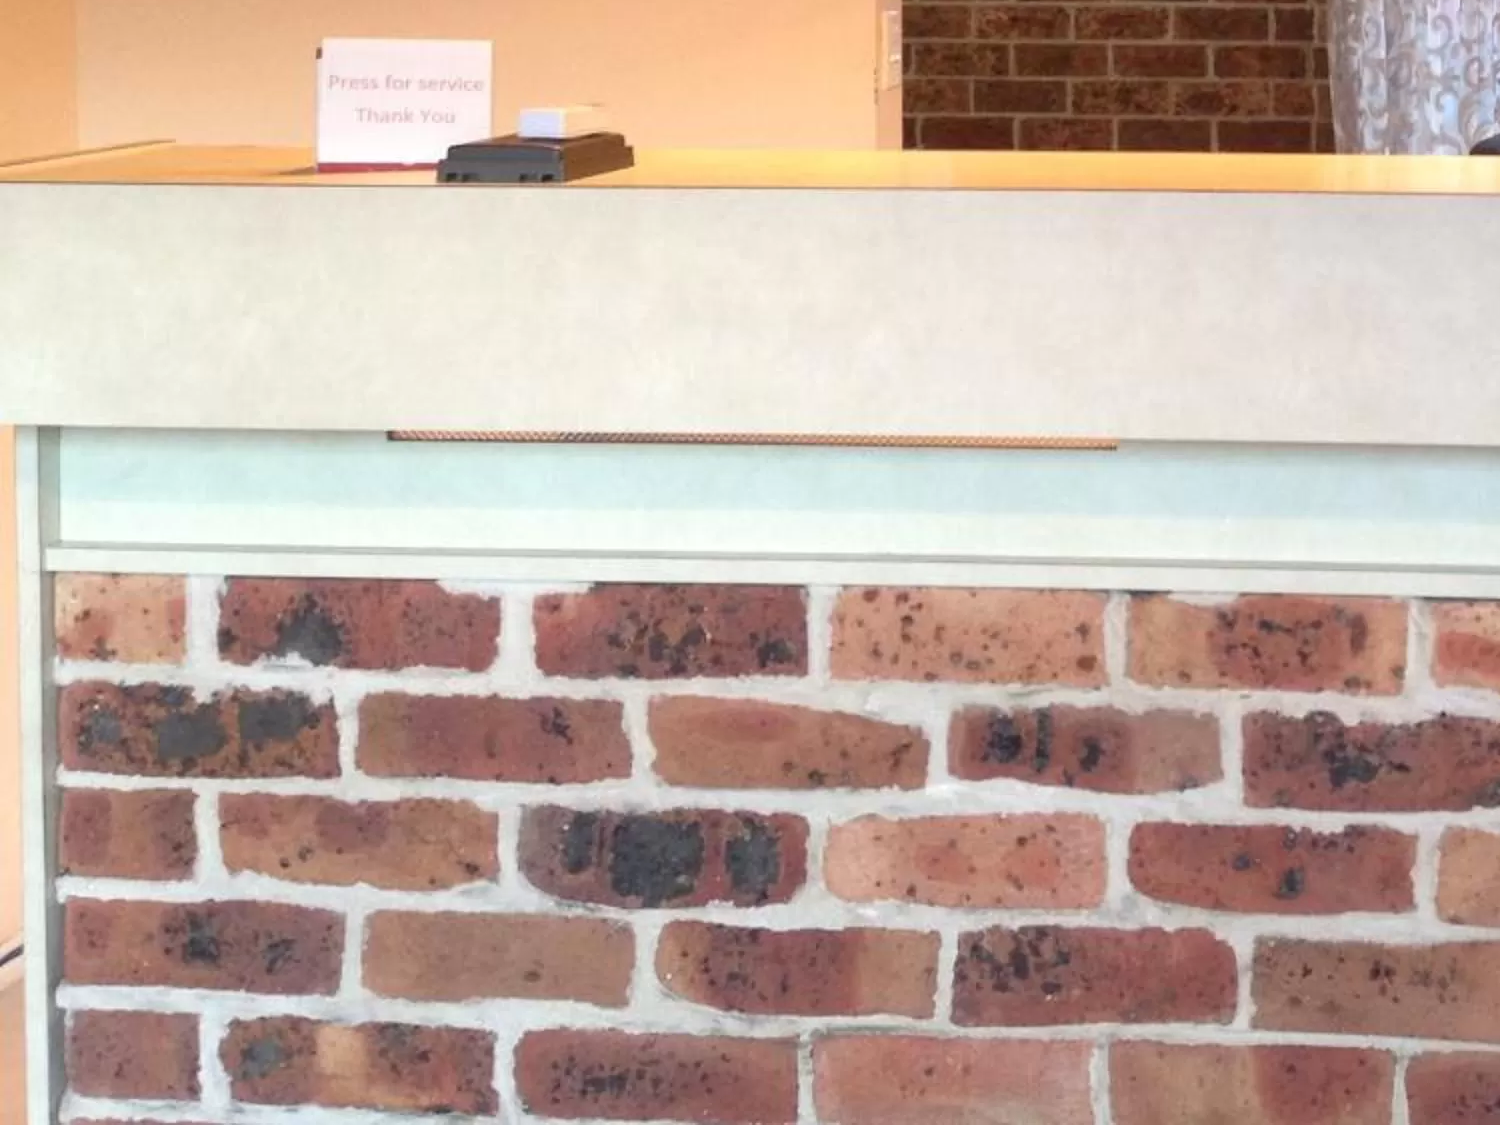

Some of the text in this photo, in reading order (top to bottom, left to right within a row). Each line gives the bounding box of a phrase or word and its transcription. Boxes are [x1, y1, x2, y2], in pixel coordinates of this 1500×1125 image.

[328, 74, 485, 92] Press for service
[354, 107, 457, 125] Thank You
